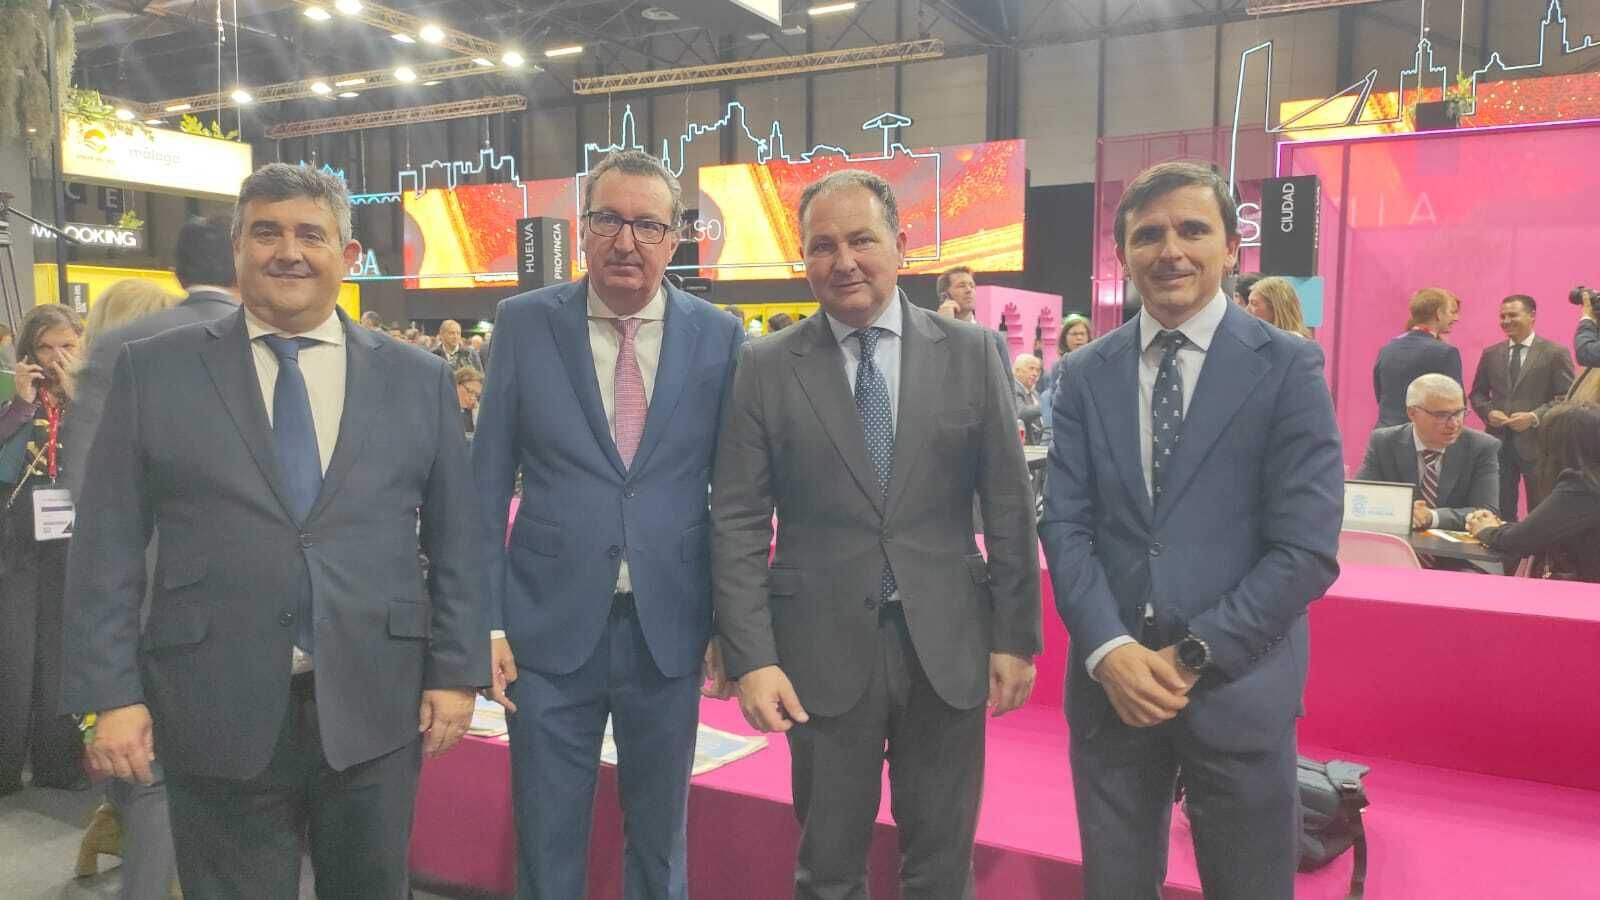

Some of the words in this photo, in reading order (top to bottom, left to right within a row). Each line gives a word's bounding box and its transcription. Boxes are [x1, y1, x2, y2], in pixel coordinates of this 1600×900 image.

[1280, 182, 1295, 232] CIUDAD
[524, 222, 535, 273] HUELVA
[552, 223, 563, 280] PROVINCIA
